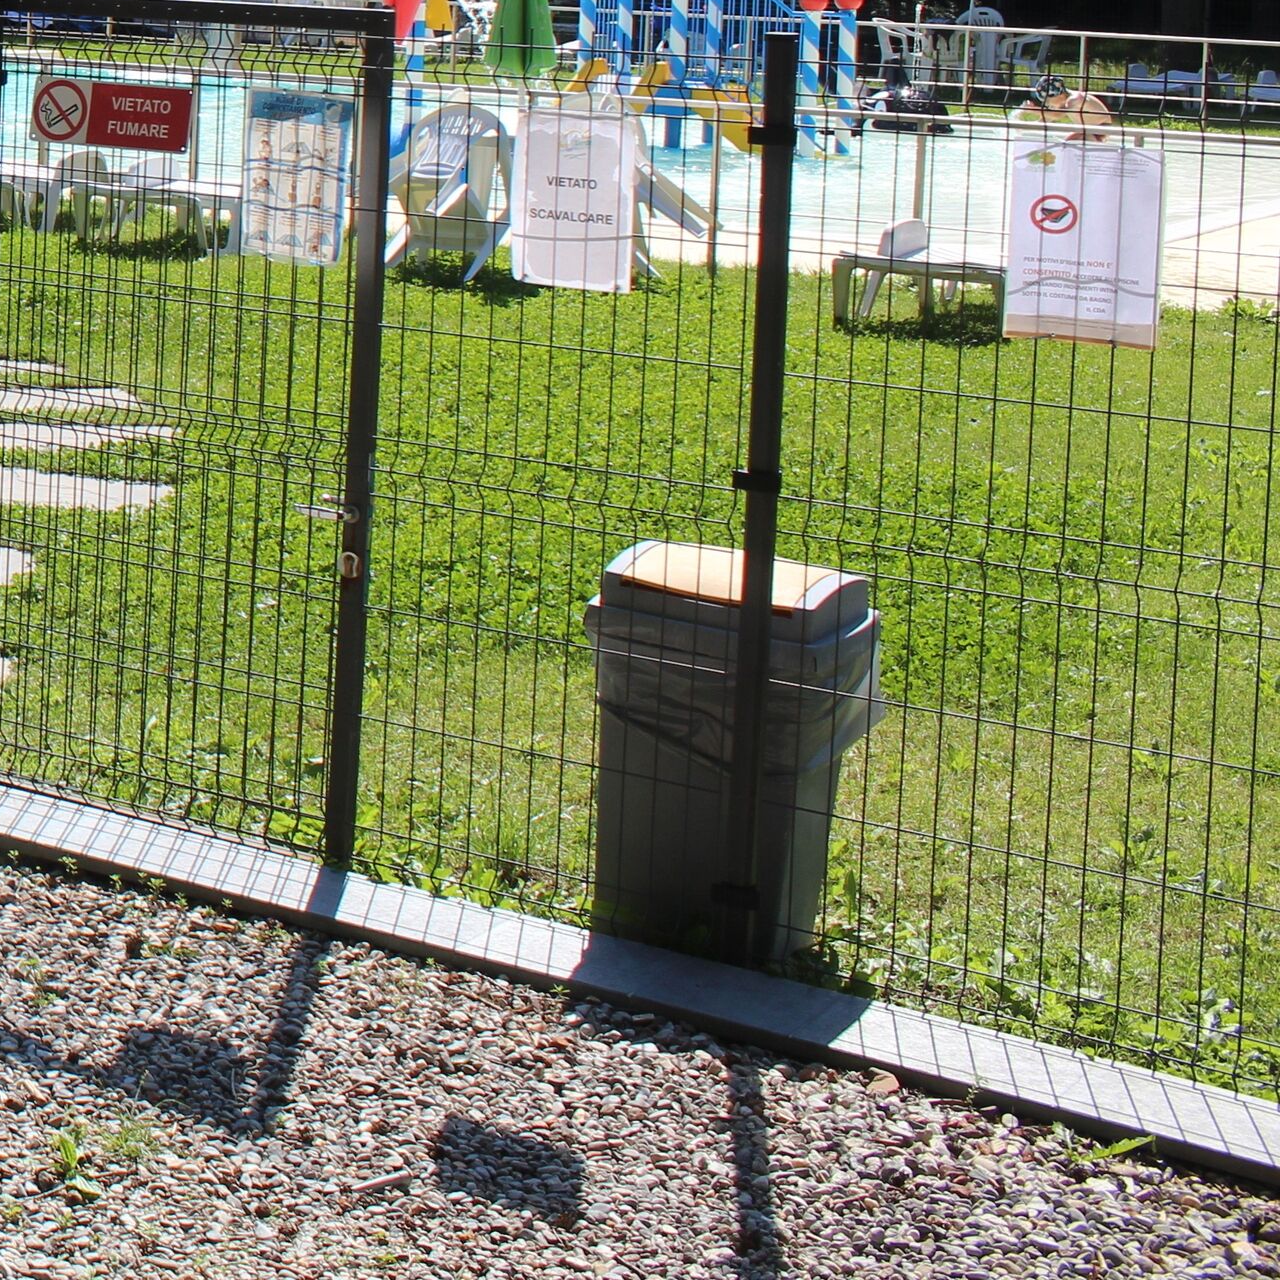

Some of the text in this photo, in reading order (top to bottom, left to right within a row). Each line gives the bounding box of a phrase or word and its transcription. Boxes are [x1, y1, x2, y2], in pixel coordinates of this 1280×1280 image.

[112, 96, 171, 114] VIETATO
[107, 120, 169, 138] FUMARE
[546, 176, 597, 190] VIETATO
[529, 207, 614, 226] SCAVALCARE
[1023, 269, 1071, 278] CONSENTITO
